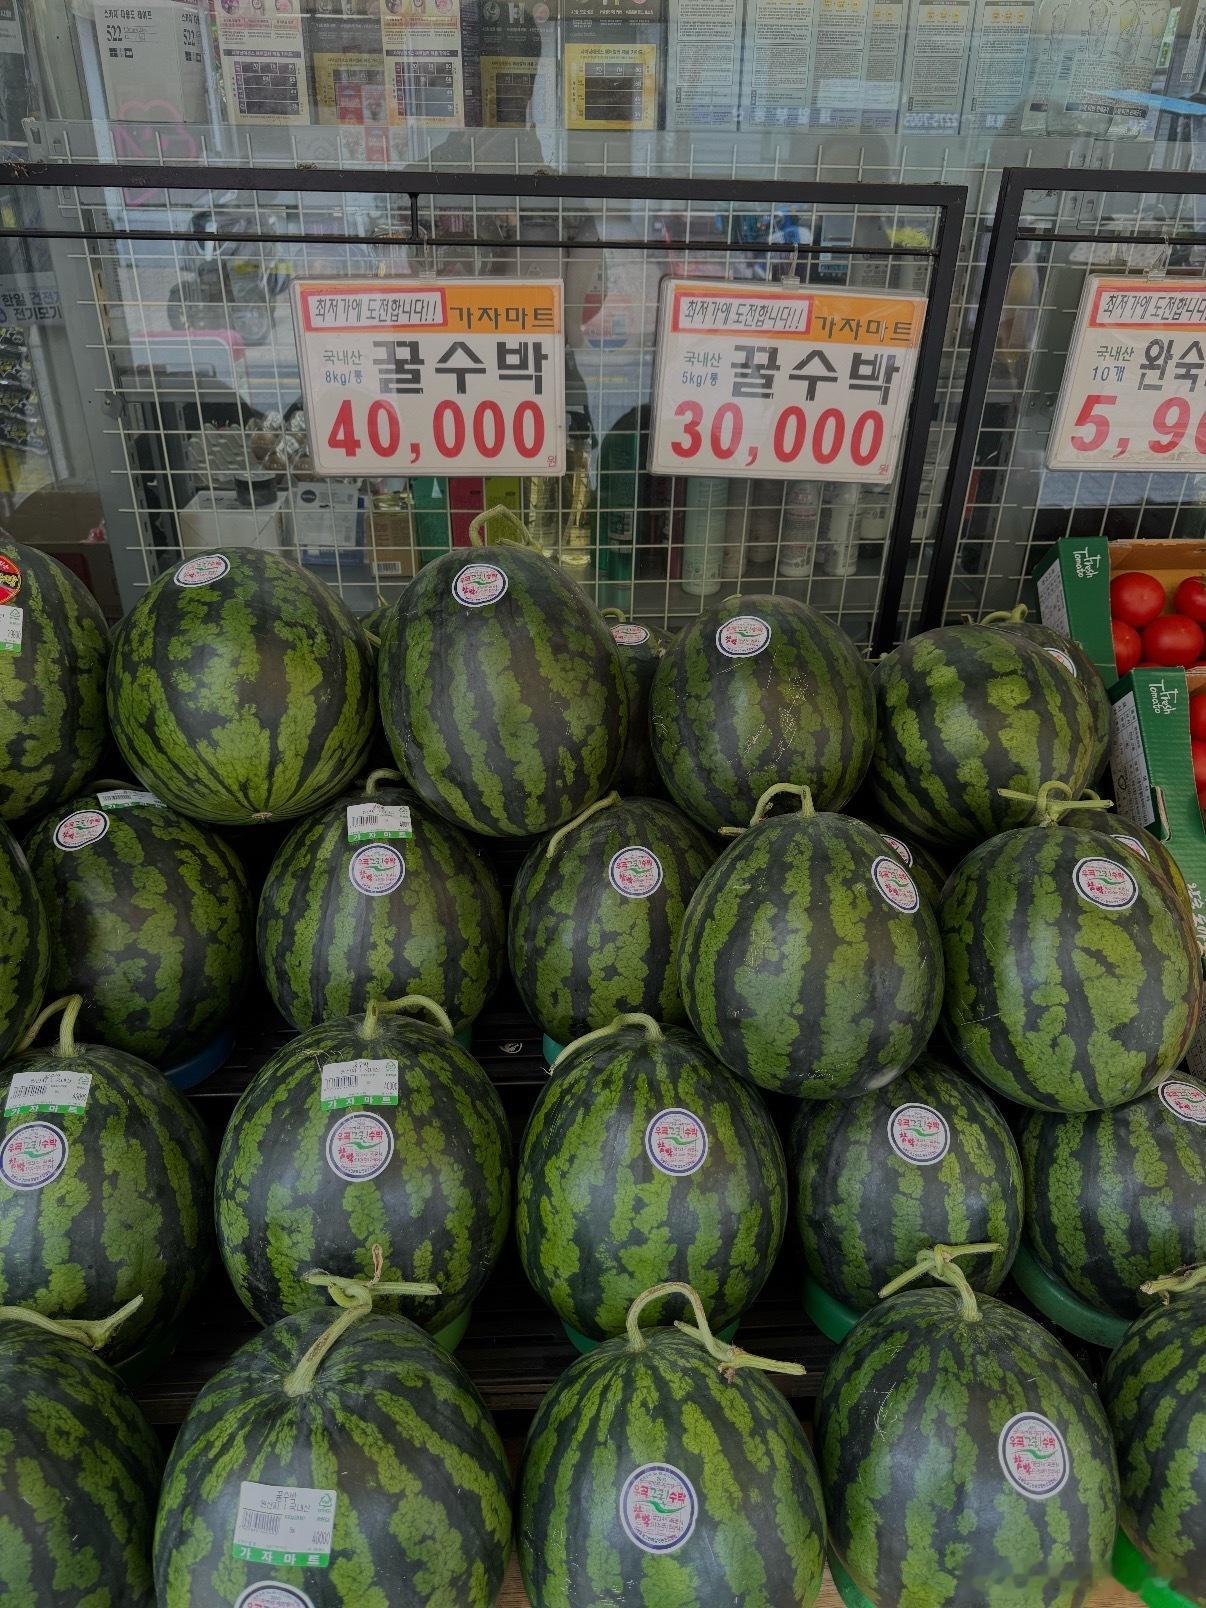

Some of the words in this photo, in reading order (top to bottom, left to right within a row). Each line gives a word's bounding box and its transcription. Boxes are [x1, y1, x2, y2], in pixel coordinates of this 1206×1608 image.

[1, 292, 26, 307] 한일
[314, 298, 362, 323] 최저가에
[366, 297, 438, 323] 도전합니다!!
[1103, 294, 1152, 320] 최저가에
[450, 306, 554, 330] 가자마트
[684, 300, 732, 327] 최저가에
[733, 303, 804, 330] 도전합니다!!
[815, 316, 913, 342] 가자마트
[322, 350, 363, 366] 국내산
[684, 350, 723, 368] 국내산
[1096, 345, 1135, 362] 국내산
[325, 370, 364, 386] 8kg/통
[372, 340, 549, 396] 꿀수박
[681, 370, 720, 390] 5kg/통
[730, 344, 900, 406] 꿀수박
[1092, 366, 1126, 382] 10개
[327, 399, 545, 464] 40,000
[671, 400, 884, 467] 30,000
[1072, 547, 1088, 579] Tomato
[1085, 554, 1102, 579] Fresh
[1149, 679, 1164, 714] Tomato
[1161, 688, 1179, 716] Fresh
